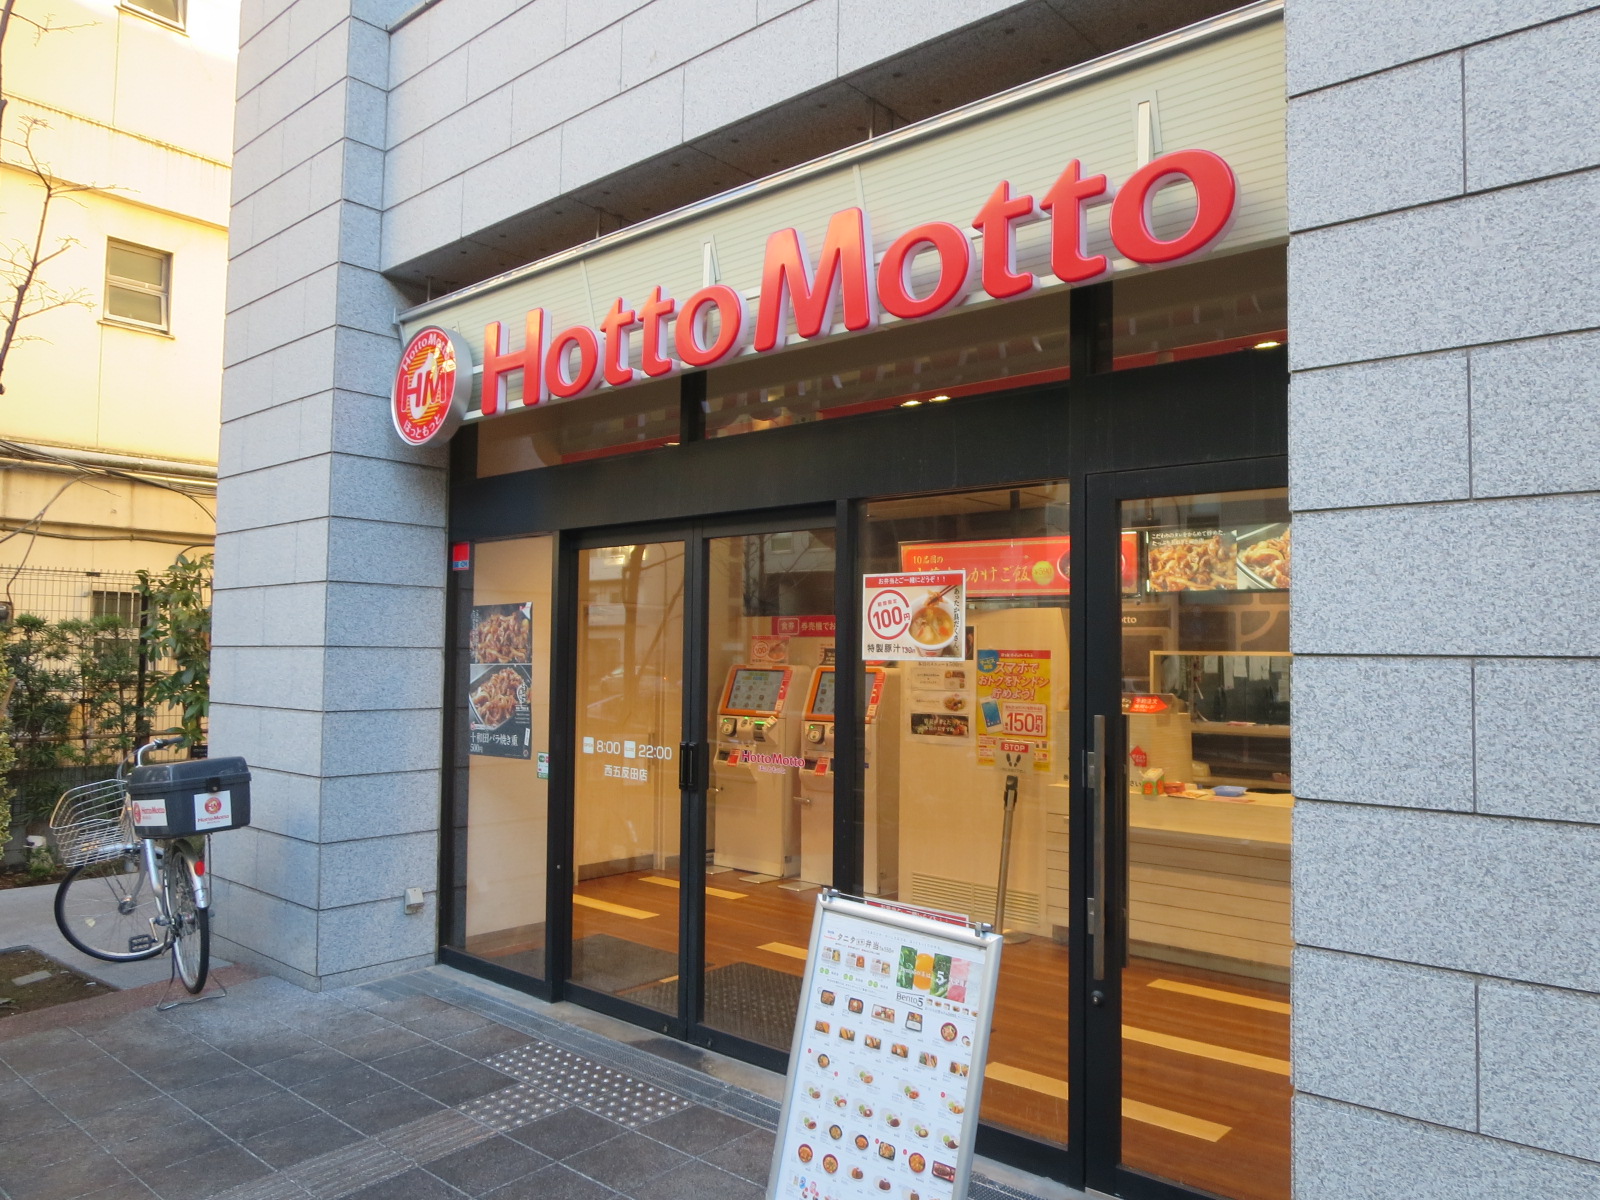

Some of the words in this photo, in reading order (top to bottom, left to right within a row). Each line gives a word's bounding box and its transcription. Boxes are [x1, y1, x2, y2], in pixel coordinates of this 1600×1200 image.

[403, 413, 442, 438] ほっともっと
[872, 606, 911, 630] 100円
[867, 643, 901, 654] 特製豚汁
[994, 661, 1039, 674] スマホで
[470, 731, 518, 747] 十和田バラ焼き重
[469, 744, 484, 753] 500円
[596, 740, 621, 754] 8:00
[638, 744, 672, 760] 22:00
[1004, 743, 1026, 752] STOP
[741, 750, 806, 767] HottoMotto
[604, 764, 648, 782] 西五反田店
